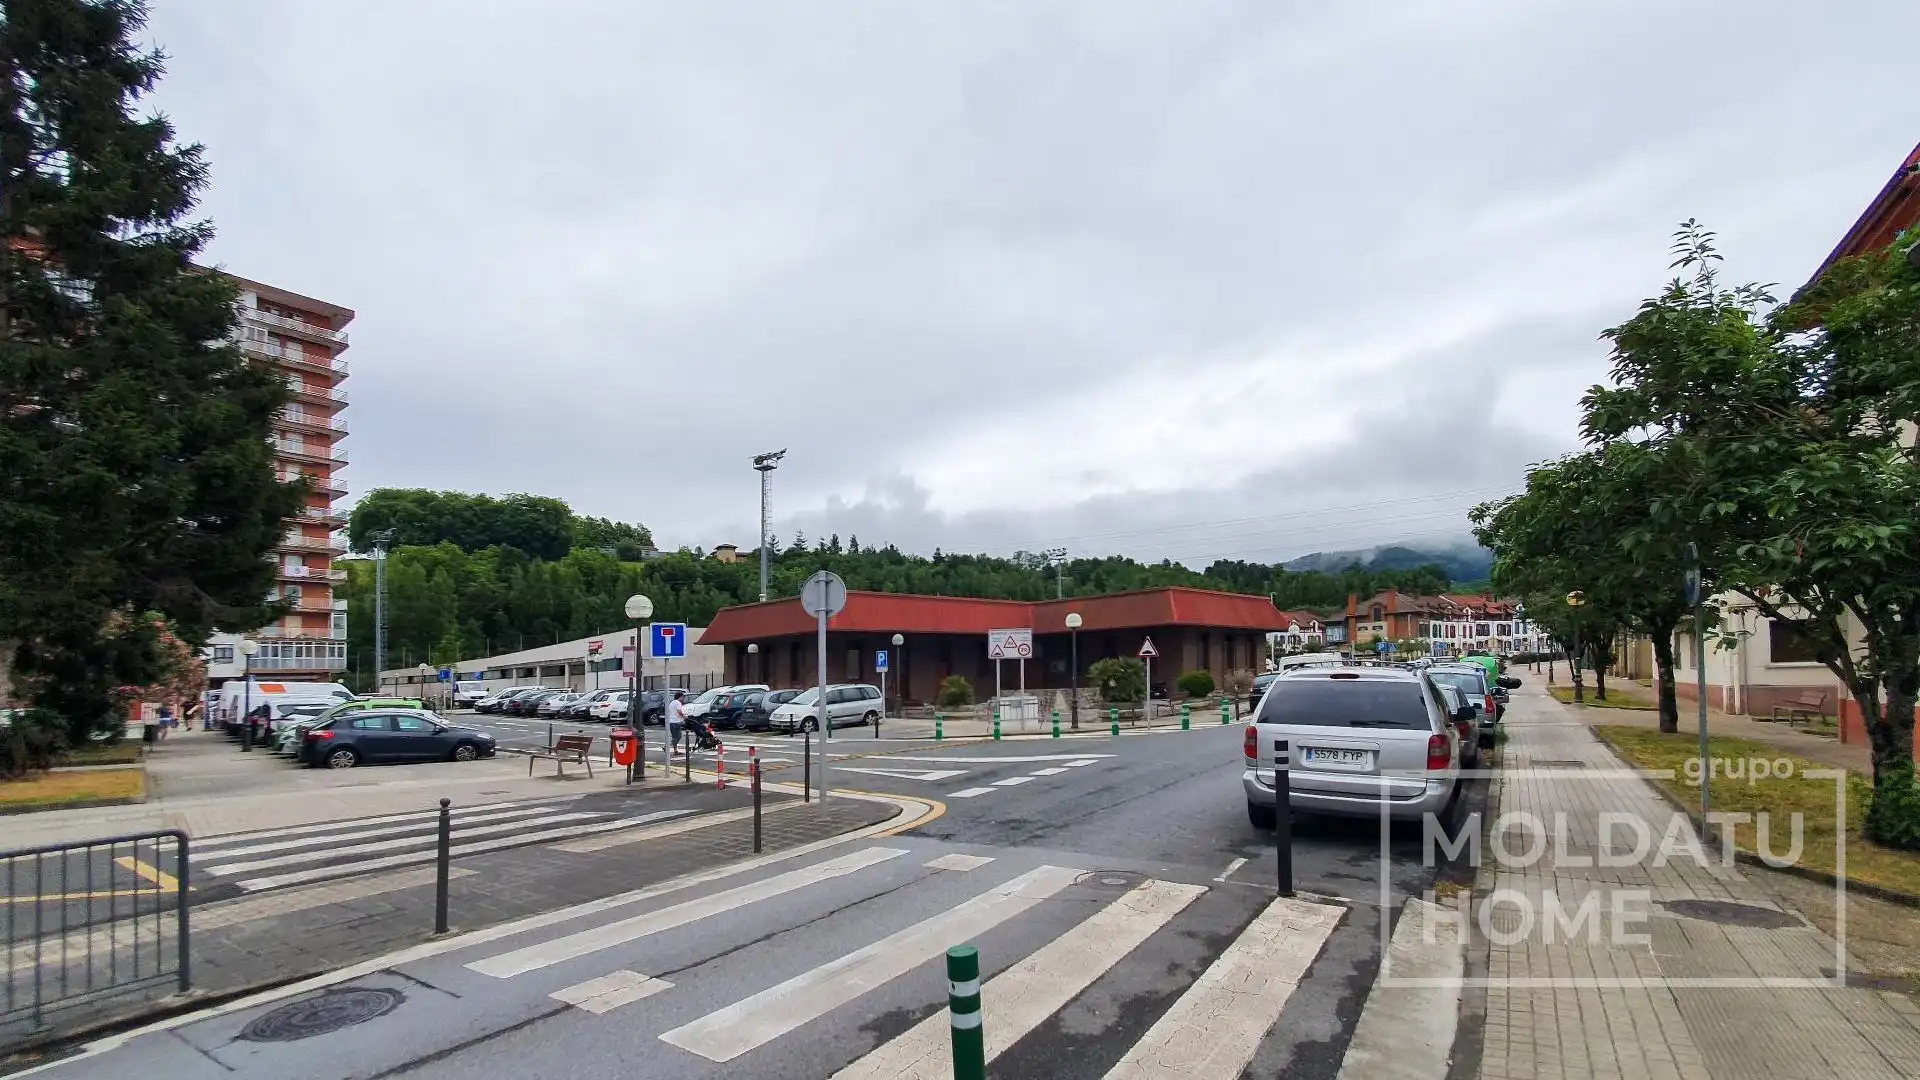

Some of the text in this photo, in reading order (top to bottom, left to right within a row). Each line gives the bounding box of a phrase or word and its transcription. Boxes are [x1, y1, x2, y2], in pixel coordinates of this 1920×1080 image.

[878, 652, 886, 665] P
[1314, 749, 1363, 761] 5578 FYP
